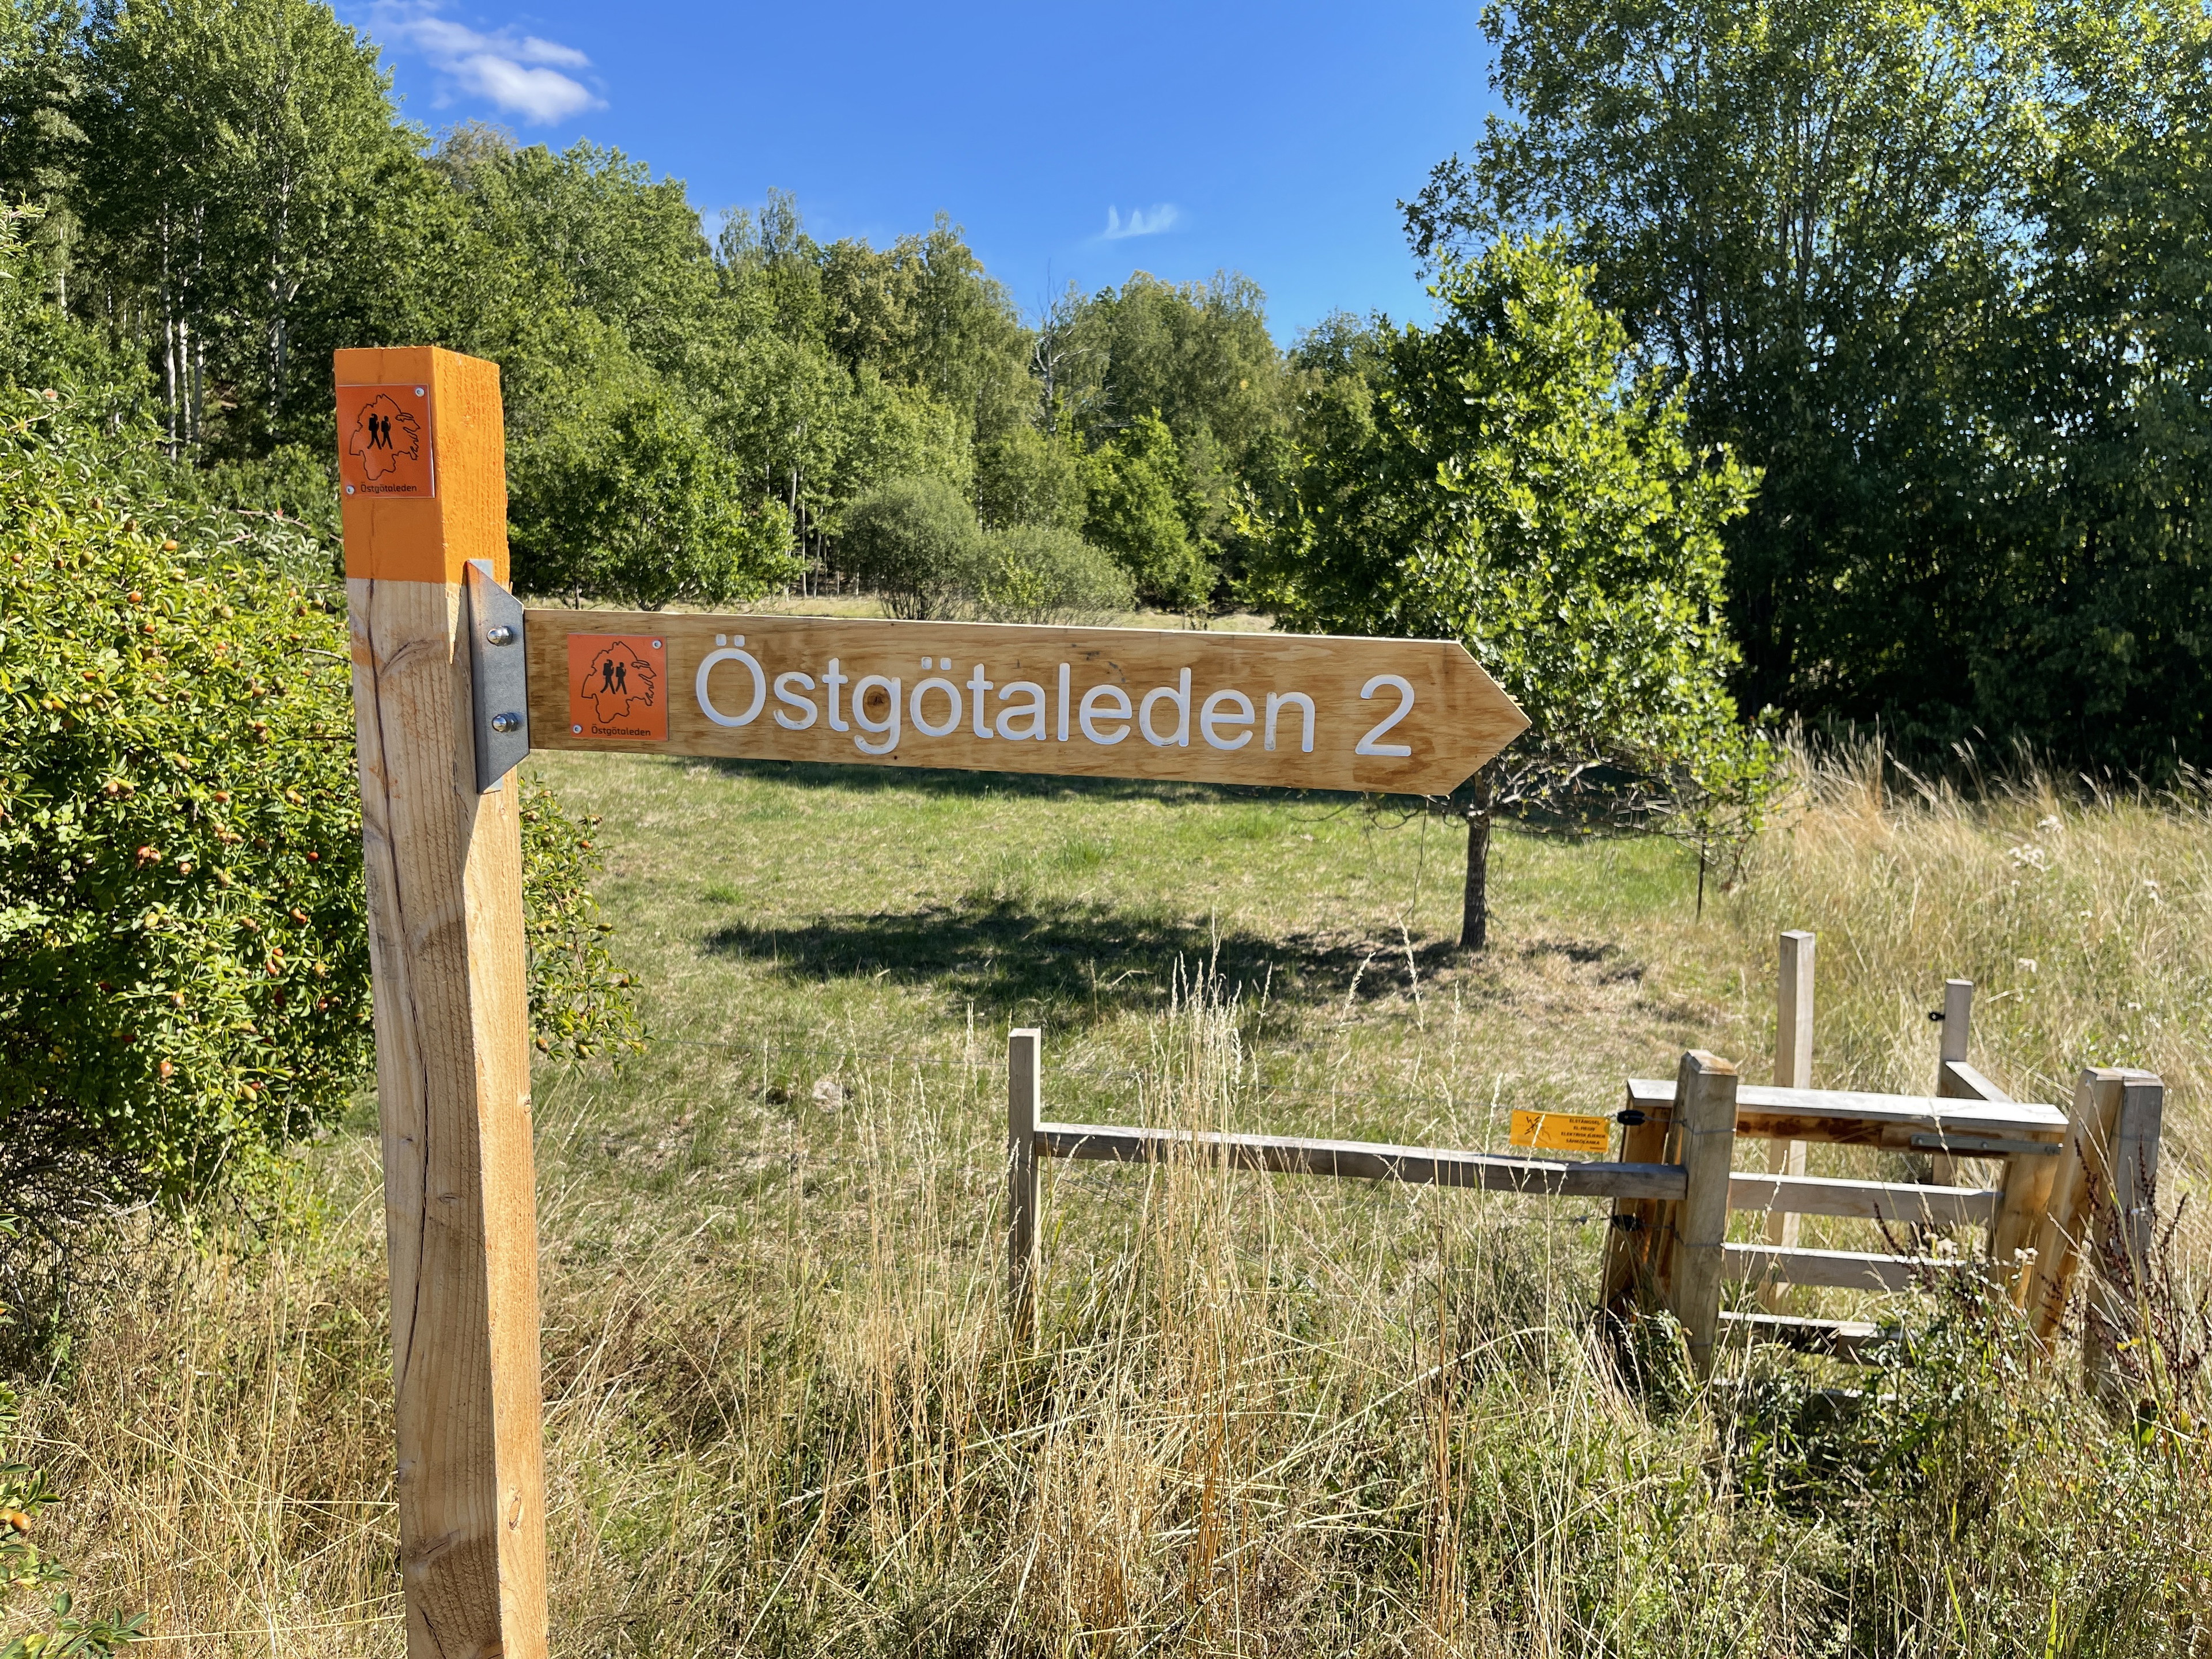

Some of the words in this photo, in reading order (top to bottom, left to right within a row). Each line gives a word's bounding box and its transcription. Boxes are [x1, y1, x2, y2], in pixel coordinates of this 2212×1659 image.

[361, 481, 417, 494] Östgötaleden
[695, 634, 1316, 755] Östgötaleden
[1355, 674, 1415, 757] 2
[591, 724, 652, 736] Östgötaleden
